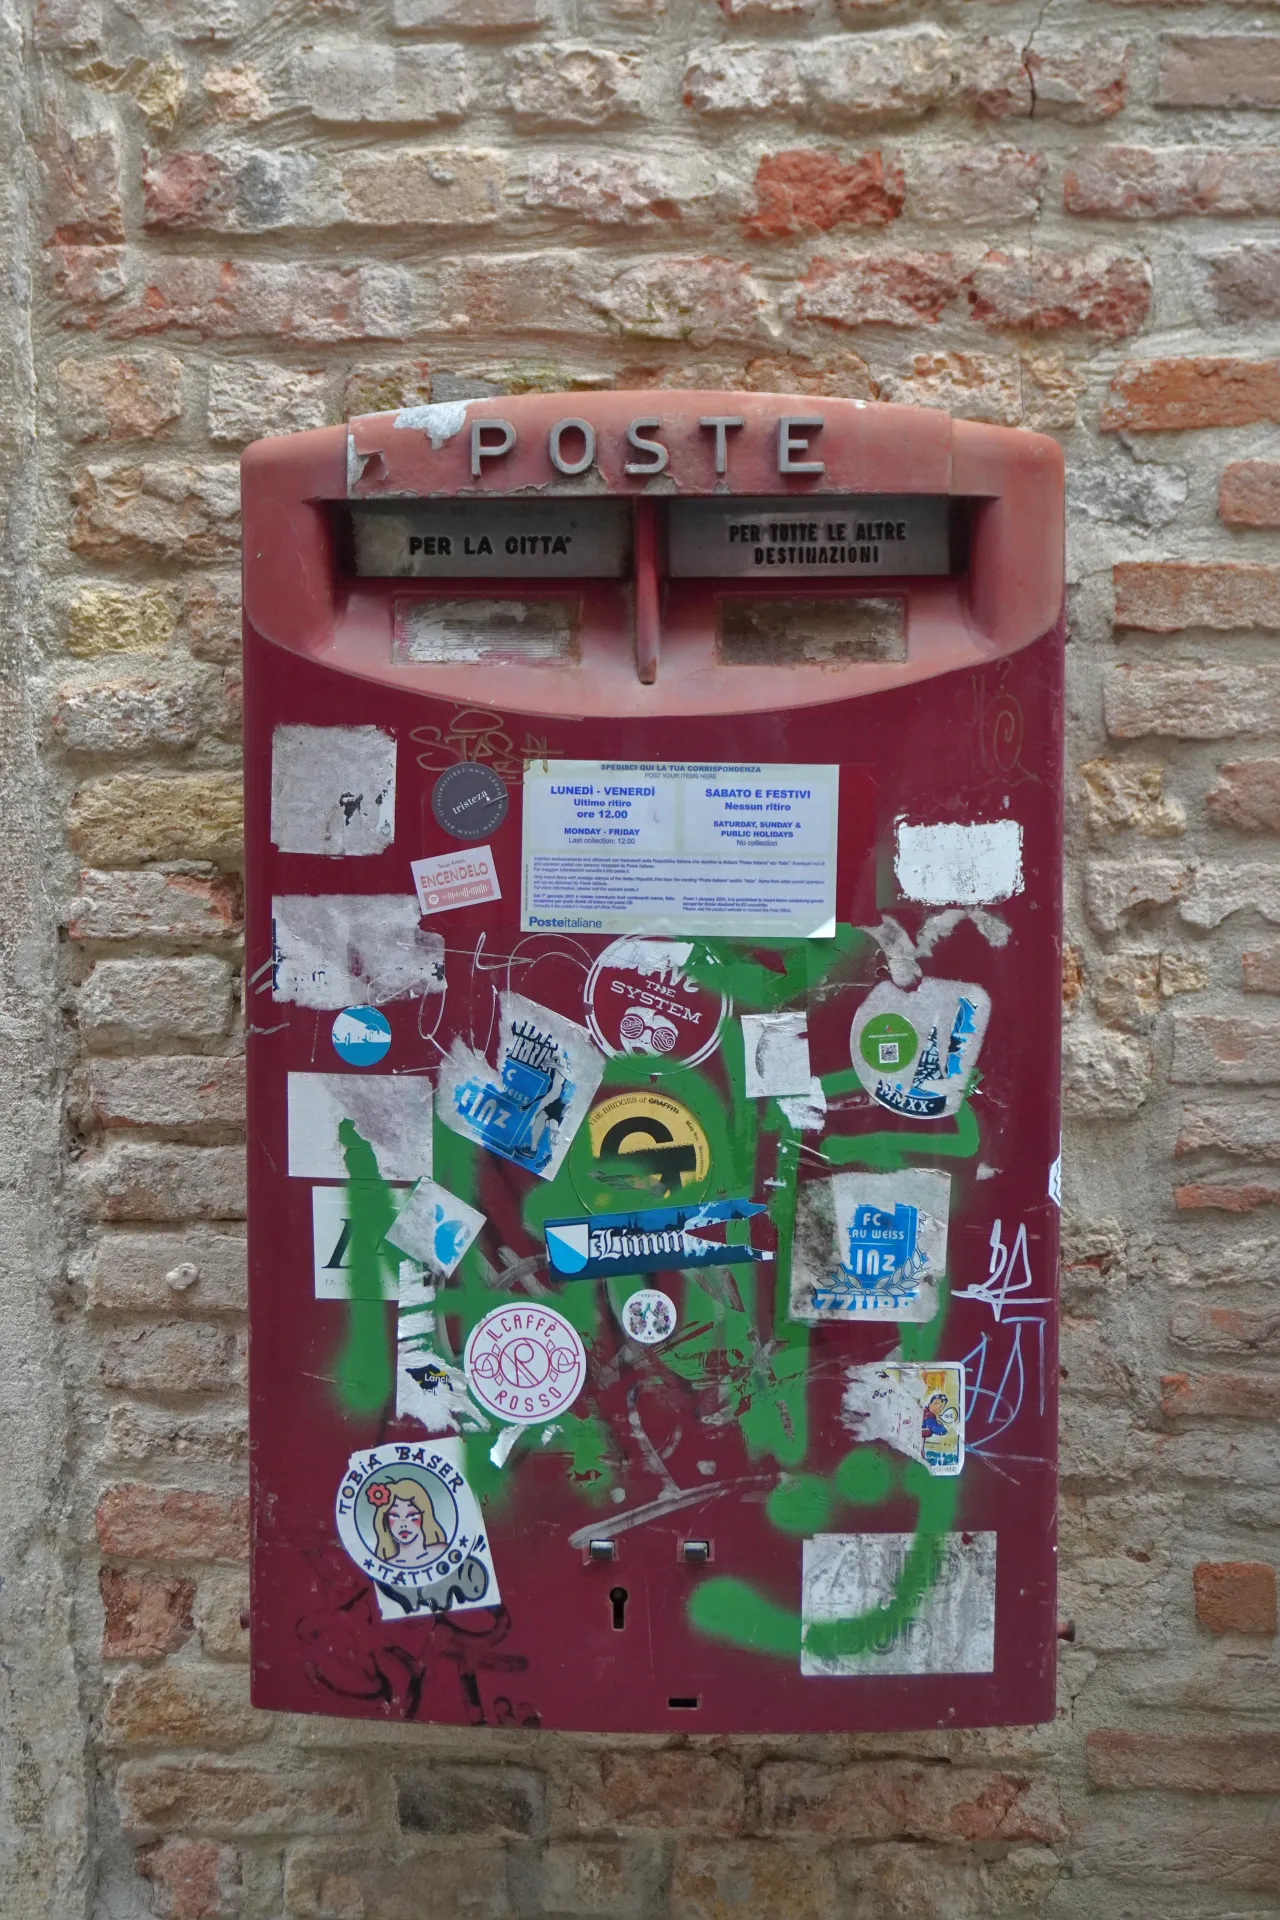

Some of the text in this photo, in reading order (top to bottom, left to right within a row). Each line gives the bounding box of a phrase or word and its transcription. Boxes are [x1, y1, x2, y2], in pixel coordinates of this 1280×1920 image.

[470, 416, 826, 477] POSTE
[729, 521, 907, 542] PER TUTTE LE ALTRE
[409, 536, 452, 555] PER
[463, 536, 493, 555] LA
[754, 546, 880, 565] DESTINAZIONI
[551, 785, 593, 795] LUNEDÌ
[604, 786, 655, 796] VENERDÌ
[706, 789, 810, 798] SABATO E FESTIVI
[452, 790, 488, 815] tristeza
[725, 802, 763, 810] Nessun
[599, 810, 627, 818] 12.00
[609, 828, 640, 836] FRIDAY
[420, 861, 489, 889] ENCENDELO
[529, 916, 602, 928] Posteitaliane
[645, 979, 677, 998] THE
[610, 980, 703, 1024] SYSTEM
[590, 1096, 680, 1126] THE BRIDGES of GRAFFITI
[685, 1120, 694, 1133] May
[862, 1212, 882, 1227] FC
[871, 1229, 905, 1240] WEISS
[486, 1329, 503, 1341] IL
[494, 1386, 562, 1412] ROSSO
[395, 1446, 464, 1493] BASER
[378, 1549, 463, 1585] TATTOO
